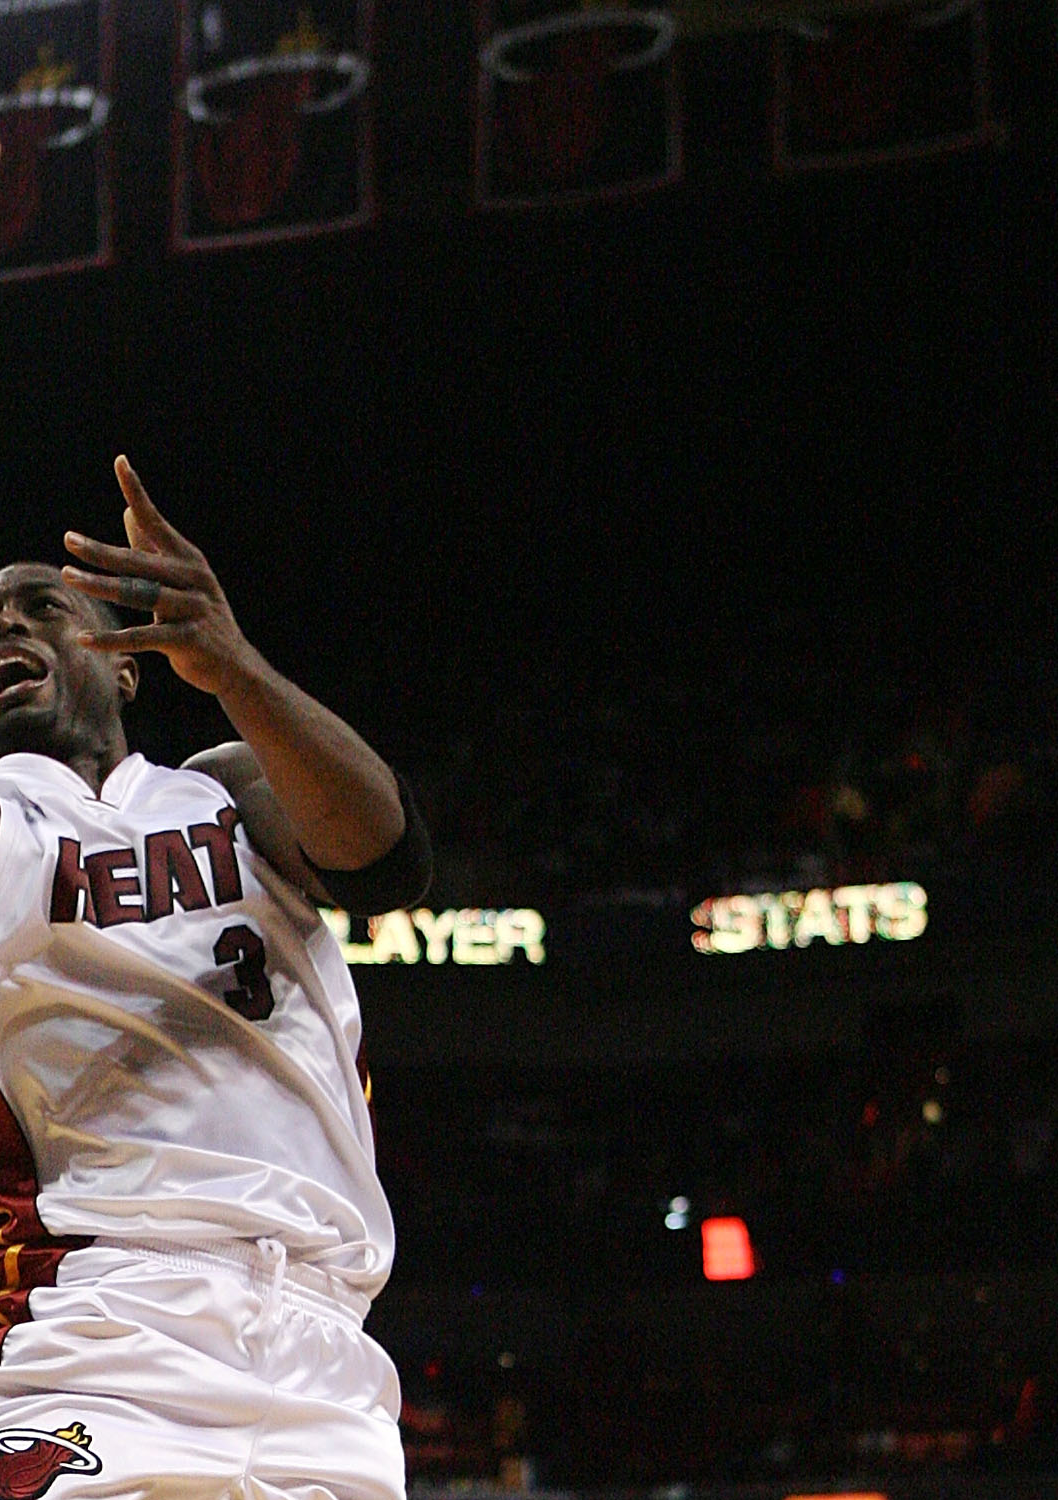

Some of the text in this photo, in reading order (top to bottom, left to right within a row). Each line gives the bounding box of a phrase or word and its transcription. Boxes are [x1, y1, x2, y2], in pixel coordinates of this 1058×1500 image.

[50, 804, 243, 928] HEAT
[318, 907, 547, 965] LAYER
[690, 881, 928, 955] STATS
[213, 924, 274, 1021] 3
